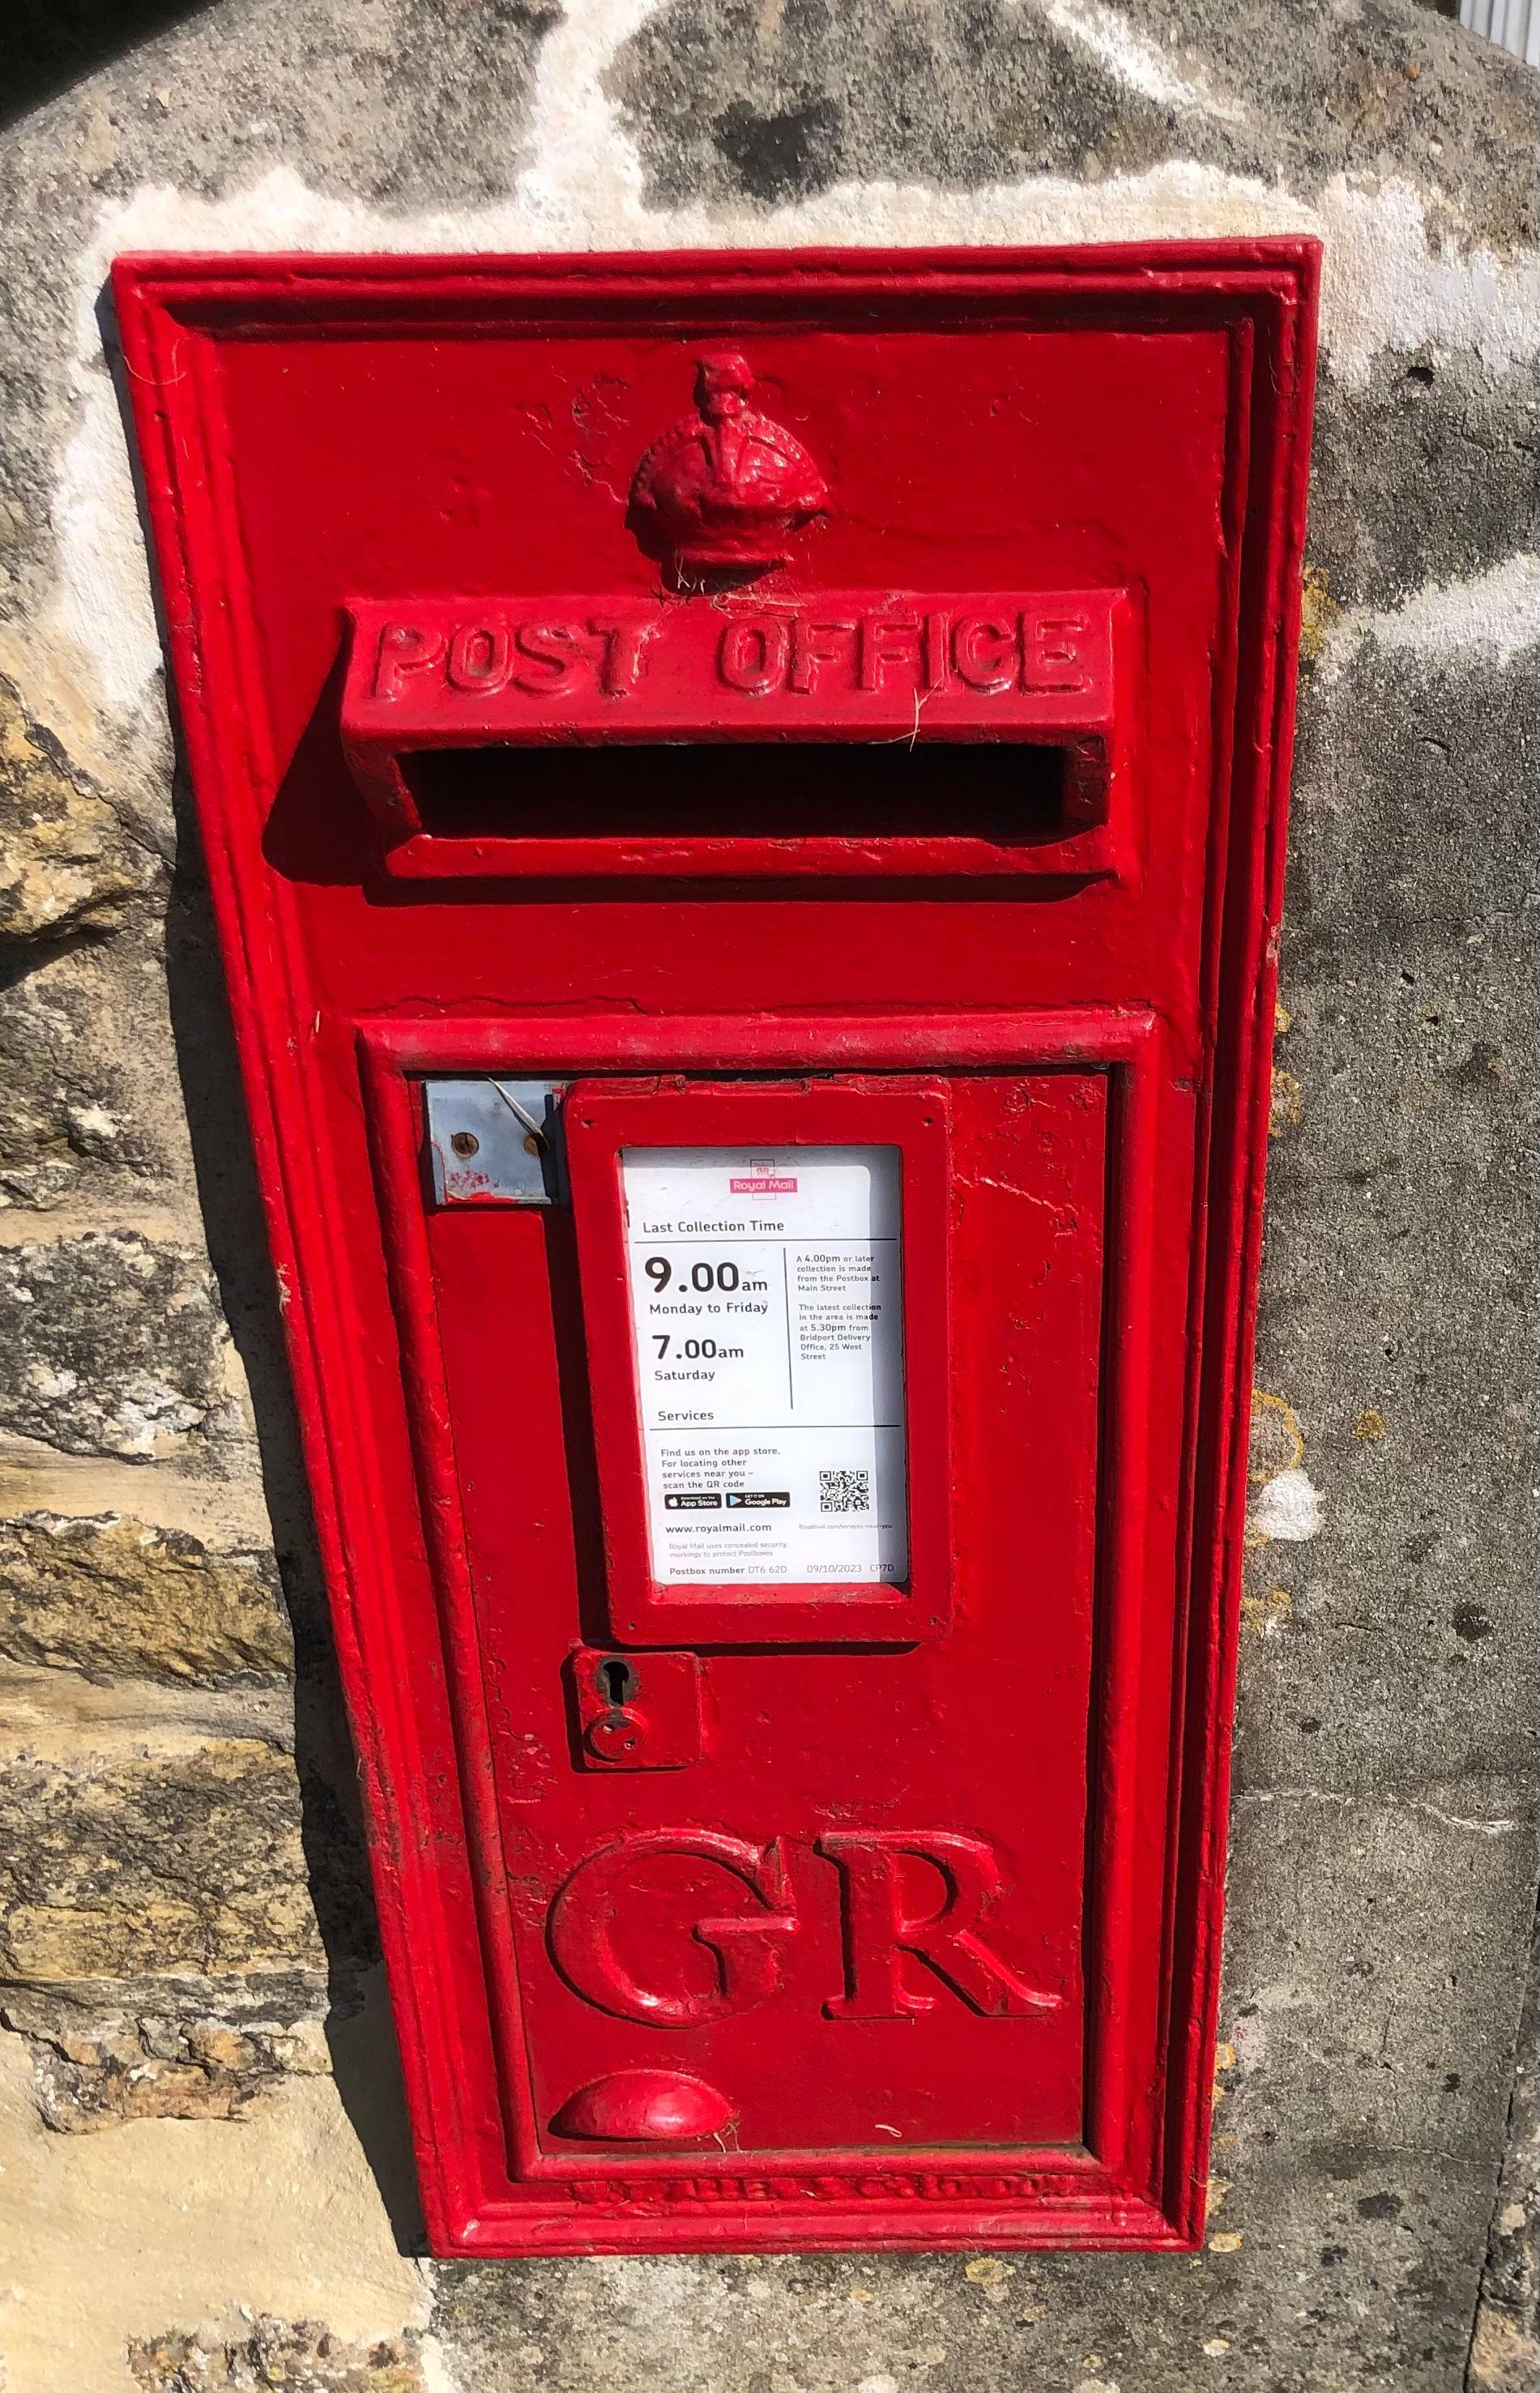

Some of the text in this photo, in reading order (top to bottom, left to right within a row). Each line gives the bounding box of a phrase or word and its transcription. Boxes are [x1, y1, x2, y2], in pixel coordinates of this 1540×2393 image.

[373, 610, 1091, 703] POST OFFICE
[734, 1180, 794, 1192] Royal Mail
[643, 1221, 784, 1233] Last Collection Time
[804, 1255, 841, 1264] 4.00pm
[645, 1257, 768, 1293] 9.00am
[650, 1302, 768, 1316] Monday to Friday
[811, 1324, 846, 1333] 5.30pm
[800, 1334, 835, 1342] Bridport
[652, 1335, 744, 1359] 7.00am
[655, 1370, 715, 1381] Saturday
[658, 1411, 715, 1422] Services
[733, 1449, 750, 1457] app
[680, 1460, 718, 1468] locating
[663, 1470, 701, 1478] services
[688, 1481, 703, 1489] the
[666, 1524, 772, 1534] www.royalmail.com
[807, 1565, 862, 1573] 09/10/2023
[547, 1827, 1064, 2029] GR
